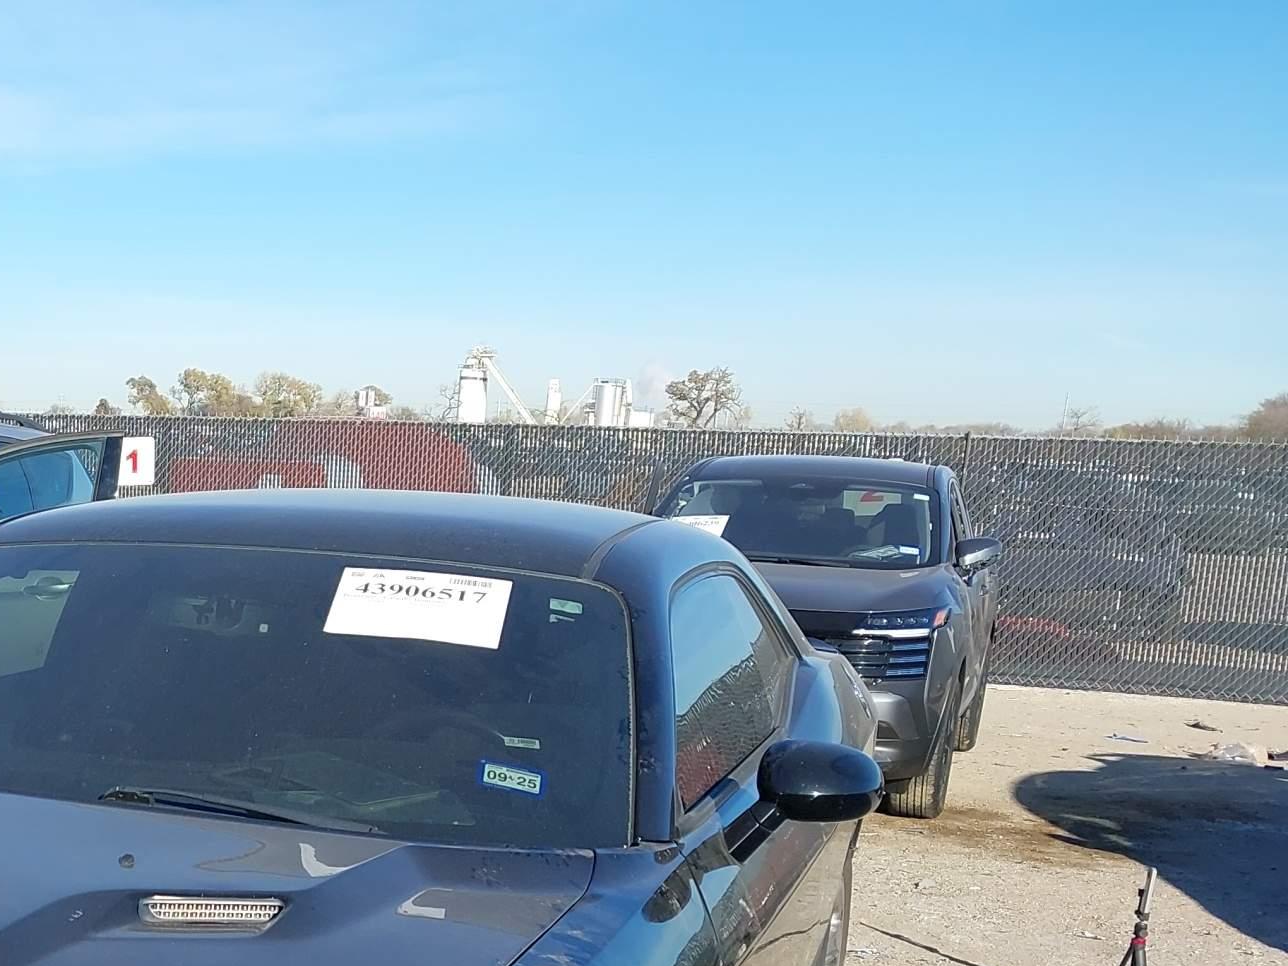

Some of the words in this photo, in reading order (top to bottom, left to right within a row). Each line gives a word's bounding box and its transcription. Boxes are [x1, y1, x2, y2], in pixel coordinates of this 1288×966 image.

[125, 448, 138, 474] 1
[355, 582, 488, 604] 43906517
[486, 769, 508, 783] 09
[516, 776, 538, 789] 25
